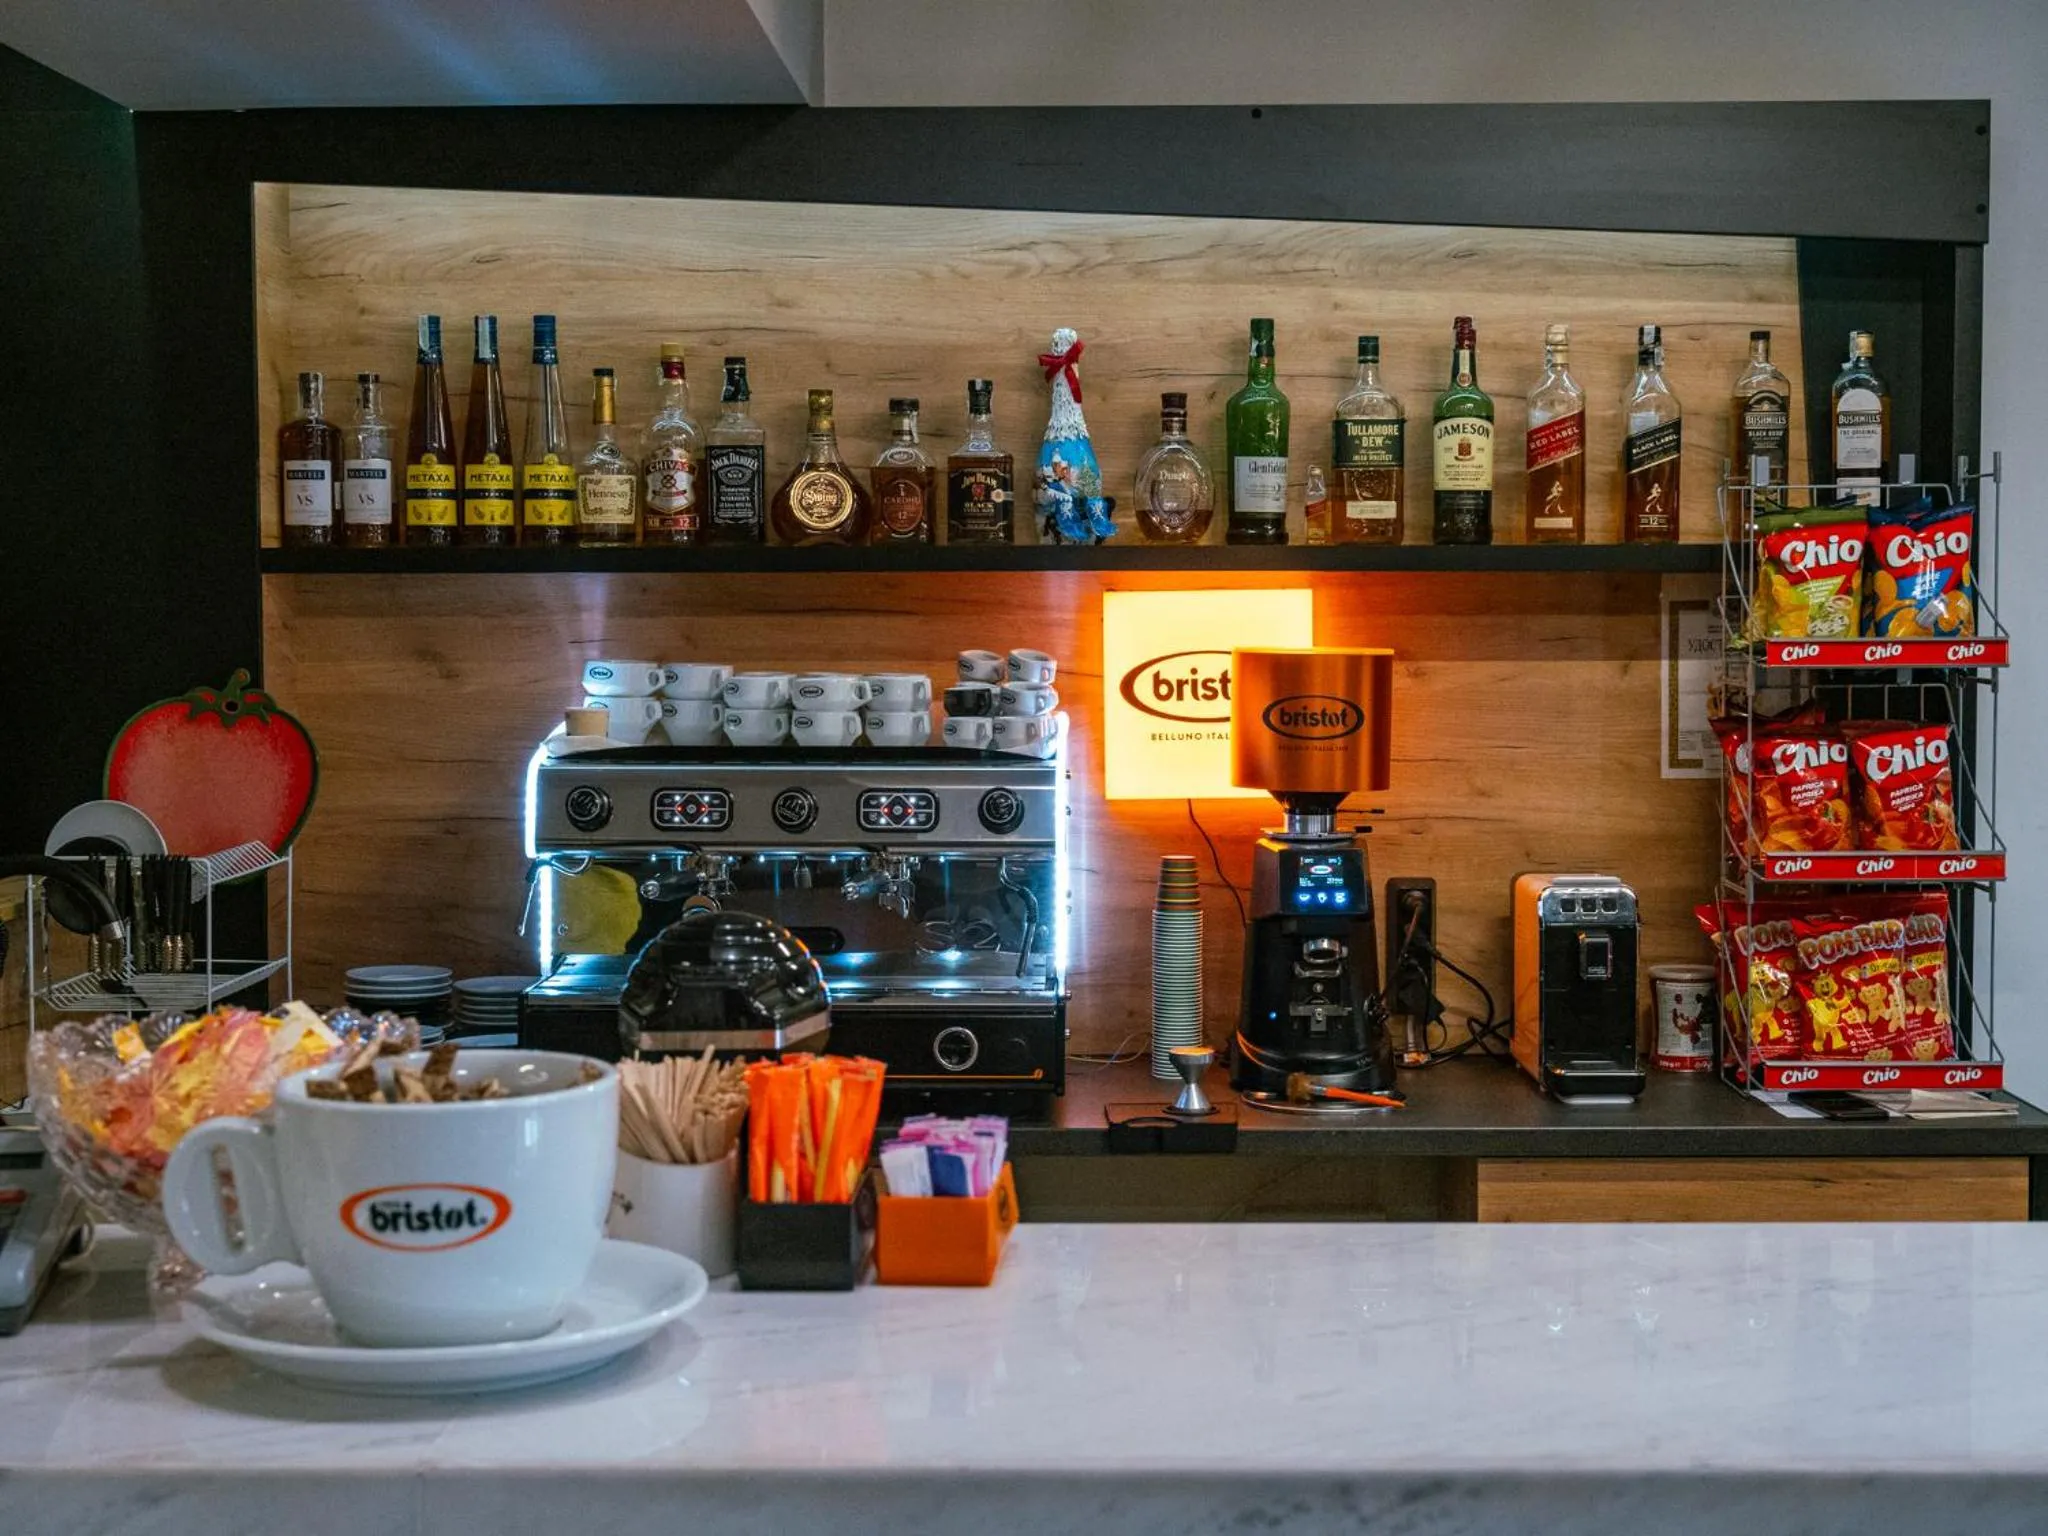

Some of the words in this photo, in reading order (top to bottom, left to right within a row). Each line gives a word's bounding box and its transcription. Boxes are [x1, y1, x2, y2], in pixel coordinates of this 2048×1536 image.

[1745, 415, 1787, 426] BUSHMILLS
[1838, 414, 1881, 424] BUSHMILLS
[1345, 421, 1399, 436] TULLAMORE
[1437, 422, 1491, 440] JAMESON
[1361, 436, 1385, 447] DEW
[1530, 437, 1548, 450] RED
[1550, 426, 1580, 442] LABEL
[1632, 442, 1655, 454] BLACK
[1655, 434, 1679, 446] LABEL
[649, 460, 690, 472] CHIVAS
[711, 455, 729, 470] JACK
[409, 474, 451, 482] METAXA
[470, 473, 512, 482] METAXA
[529, 473, 570, 482] METAXA
[589, 490, 628, 499] Hennessy
[1780, 534, 1864, 573] Chio
[1886, 531, 1969, 568] Chio
[1781, 643, 1820, 662] Chio
[1864, 643, 1903, 662] Chio
[1947, 642, 1986, 661] Chio
[1153, 667, 1231, 702] brist
[1279, 705, 1349, 728] bristot
[1151, 732, 1203, 741] BELLUNO
[1207, 732, 1231, 740] ITAL
[1772, 740, 1847, 776] Chio
[1866, 736, 1950, 784] Chio
[1774, 856, 1812, 875] Chio
[1856, 856, 1895, 875] Chio
[1939, 856, 1978, 875] Chio
[1781, 1067, 1819, 1085] Chio
[1862, 1067, 1901, 1085] Chio
[1944, 1067, 1982, 1085] Chio
